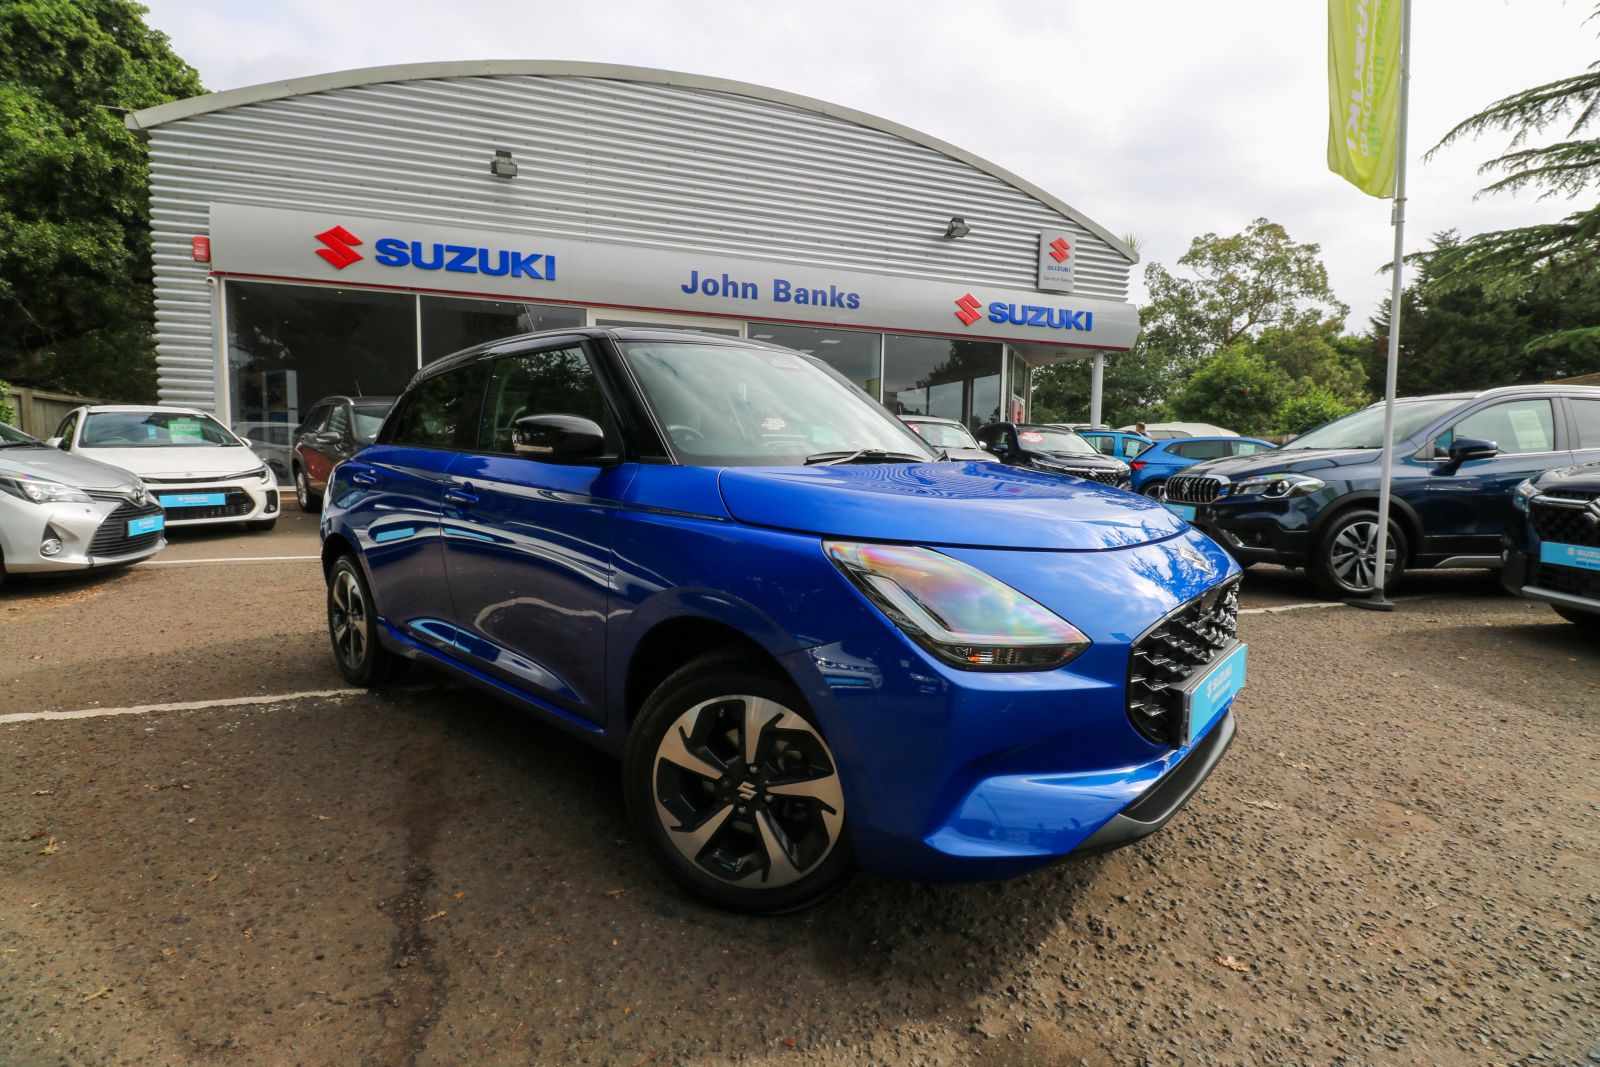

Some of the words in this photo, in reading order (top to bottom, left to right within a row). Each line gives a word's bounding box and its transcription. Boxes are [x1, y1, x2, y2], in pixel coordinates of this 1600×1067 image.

[375, 238, 556, 281] SUZUKI
[1047, 265, 1071, 273] SUZUKI
[681, 270, 758, 300] John
[773, 278, 860, 310] Banks
[988, 301, 1093, 331] SUZUKI
